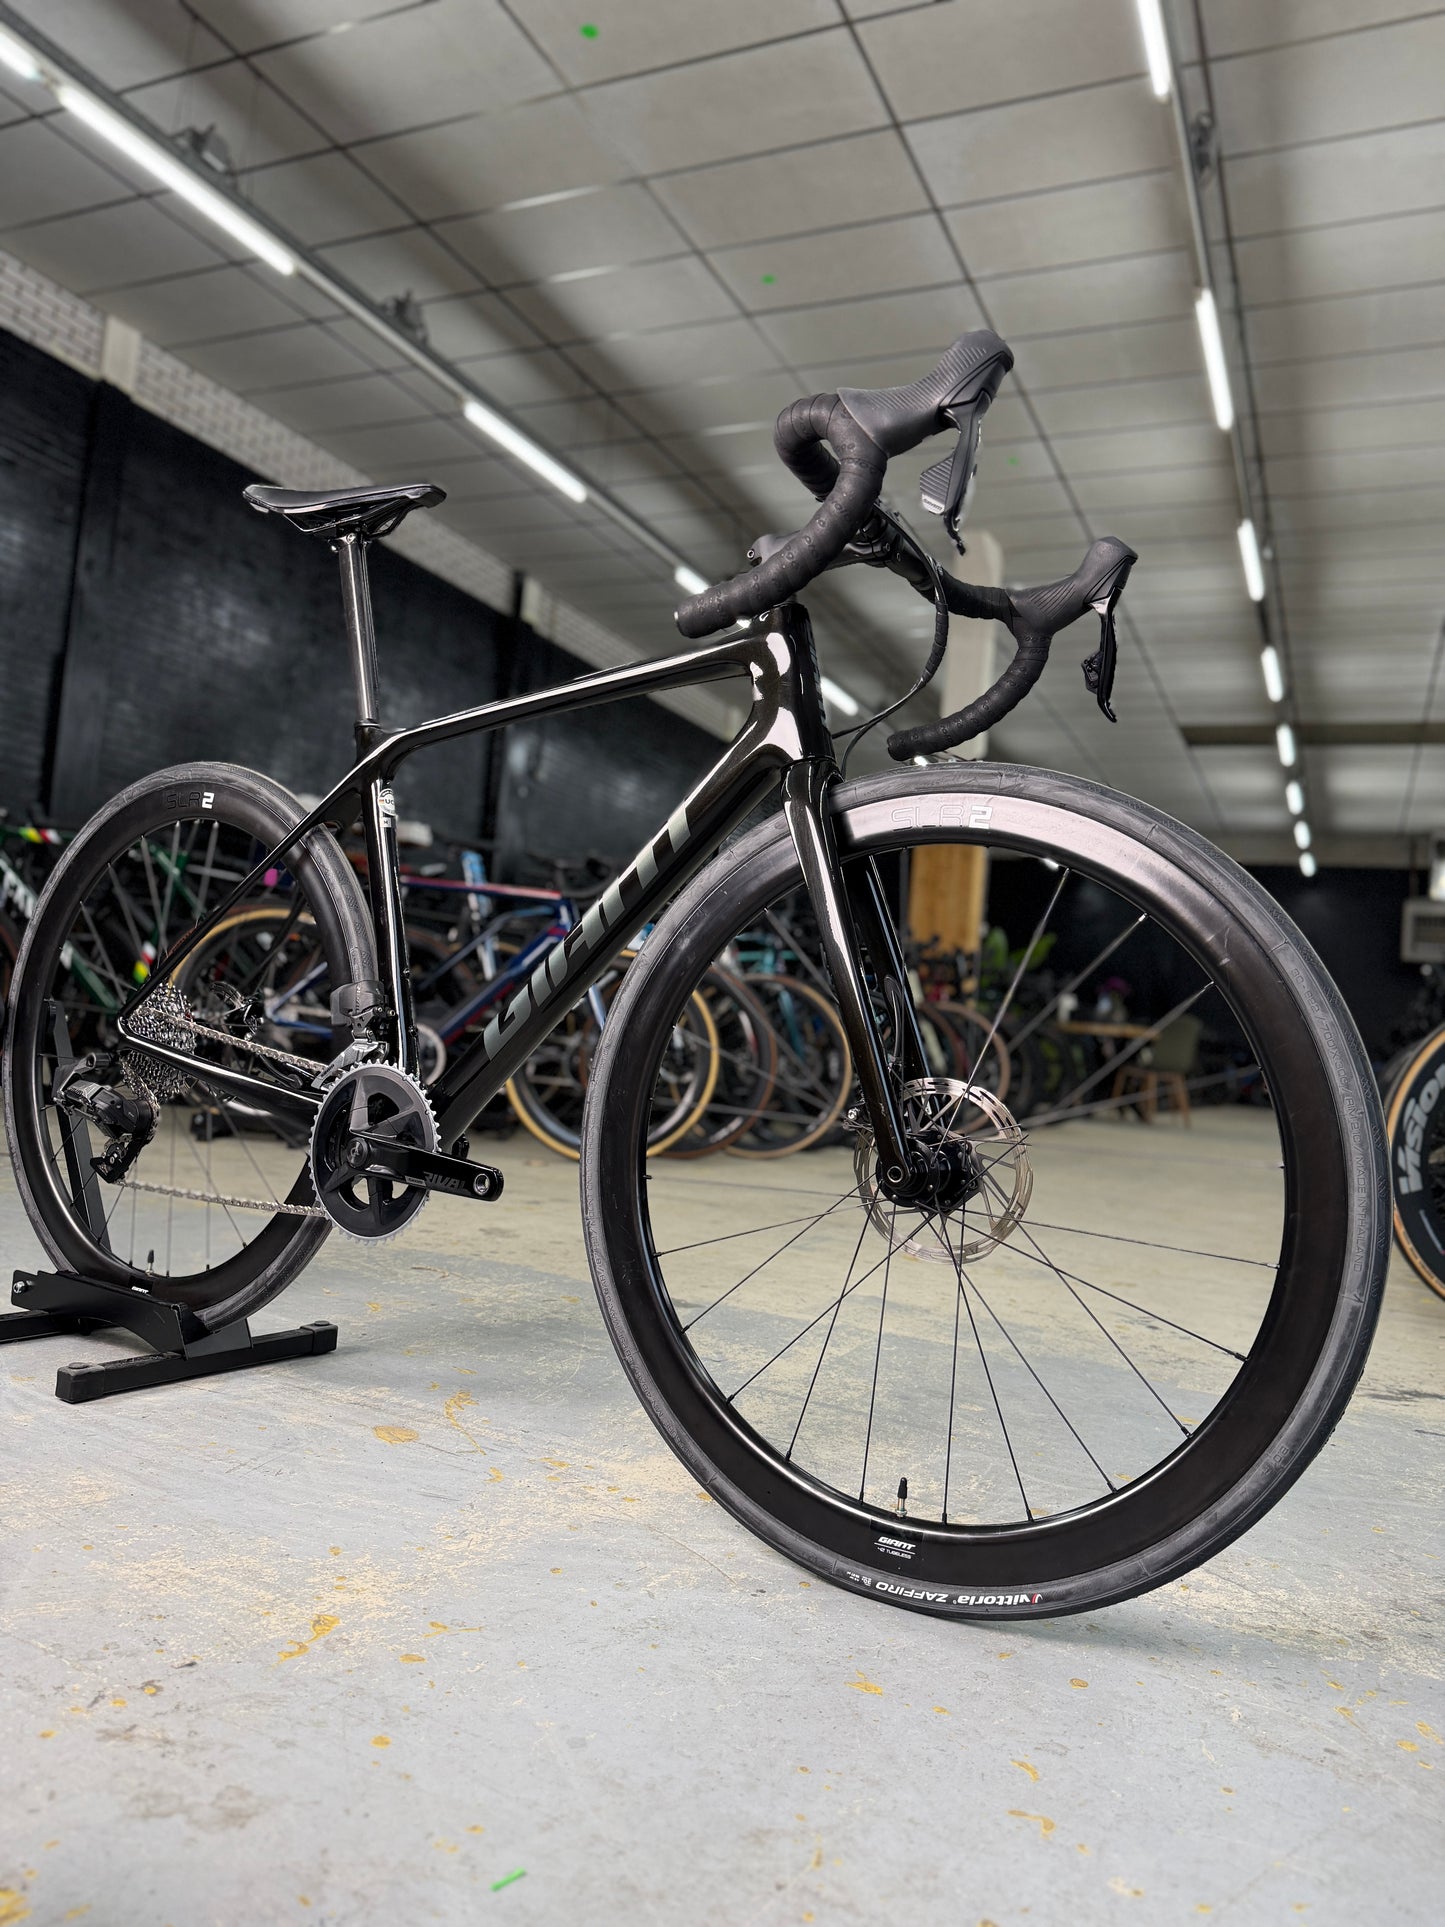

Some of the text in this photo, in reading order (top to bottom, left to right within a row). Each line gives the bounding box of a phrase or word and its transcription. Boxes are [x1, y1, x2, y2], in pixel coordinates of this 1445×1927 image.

[423, 1171, 466, 1189] RIVAL
[1354, 1155, 1366, 1194] MADE
[1358, 1196, 1367, 1208] IN
[1353, 1211, 1366, 1272] THAILAND
[878, 1535, 916, 1550] GIANT
[875, 1580, 949, 1603] ZAFFIRO
[957, 1593, 1031, 1606] vittoria
